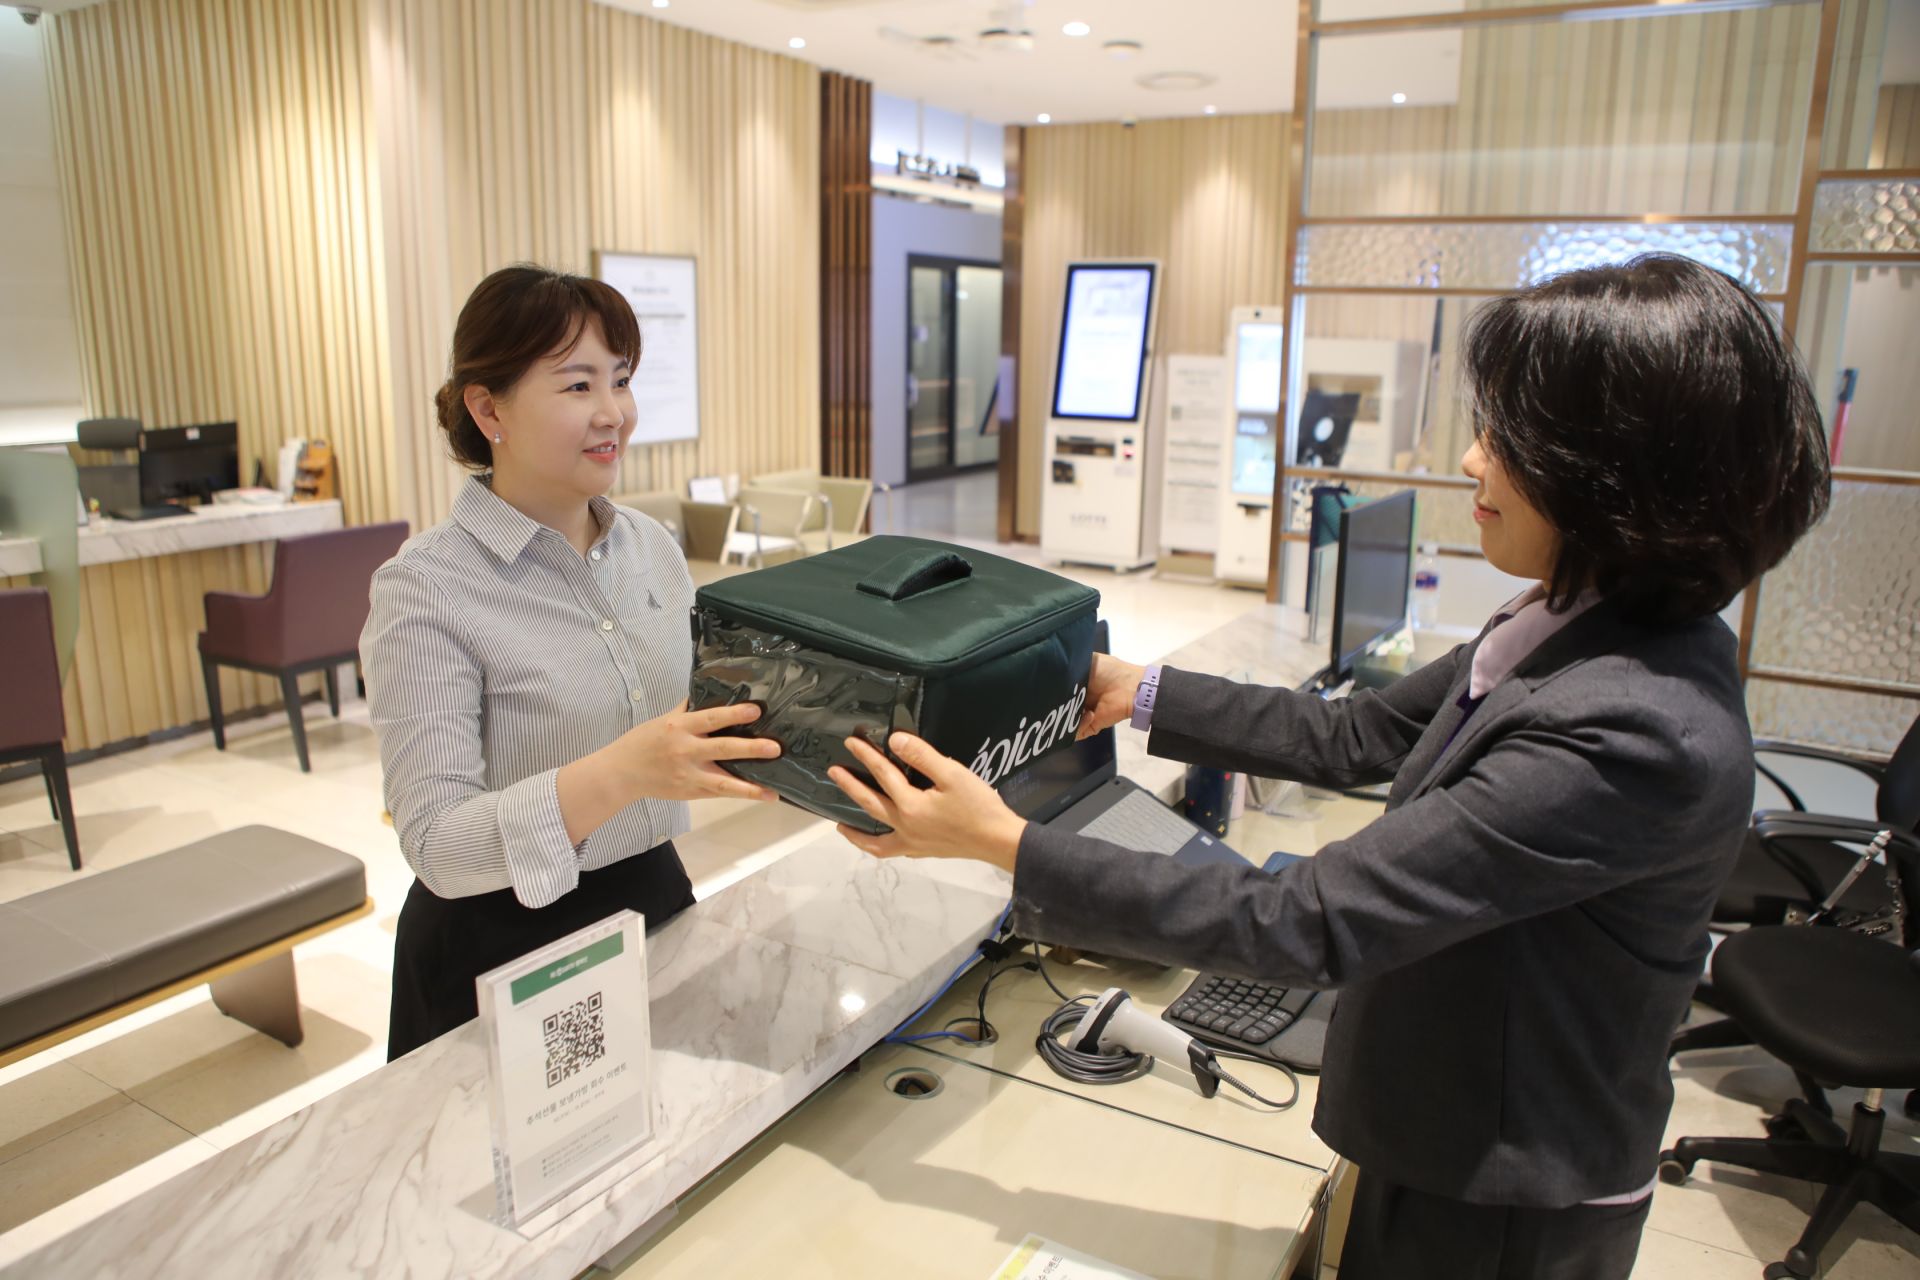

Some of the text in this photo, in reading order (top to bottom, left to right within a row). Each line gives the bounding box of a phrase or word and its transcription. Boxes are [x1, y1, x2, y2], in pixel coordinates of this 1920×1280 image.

[969, 683, 1087, 786] épicerie
[590, 1076, 605, 1089] 회수
[606, 1062, 627, 1079] 이벤트
